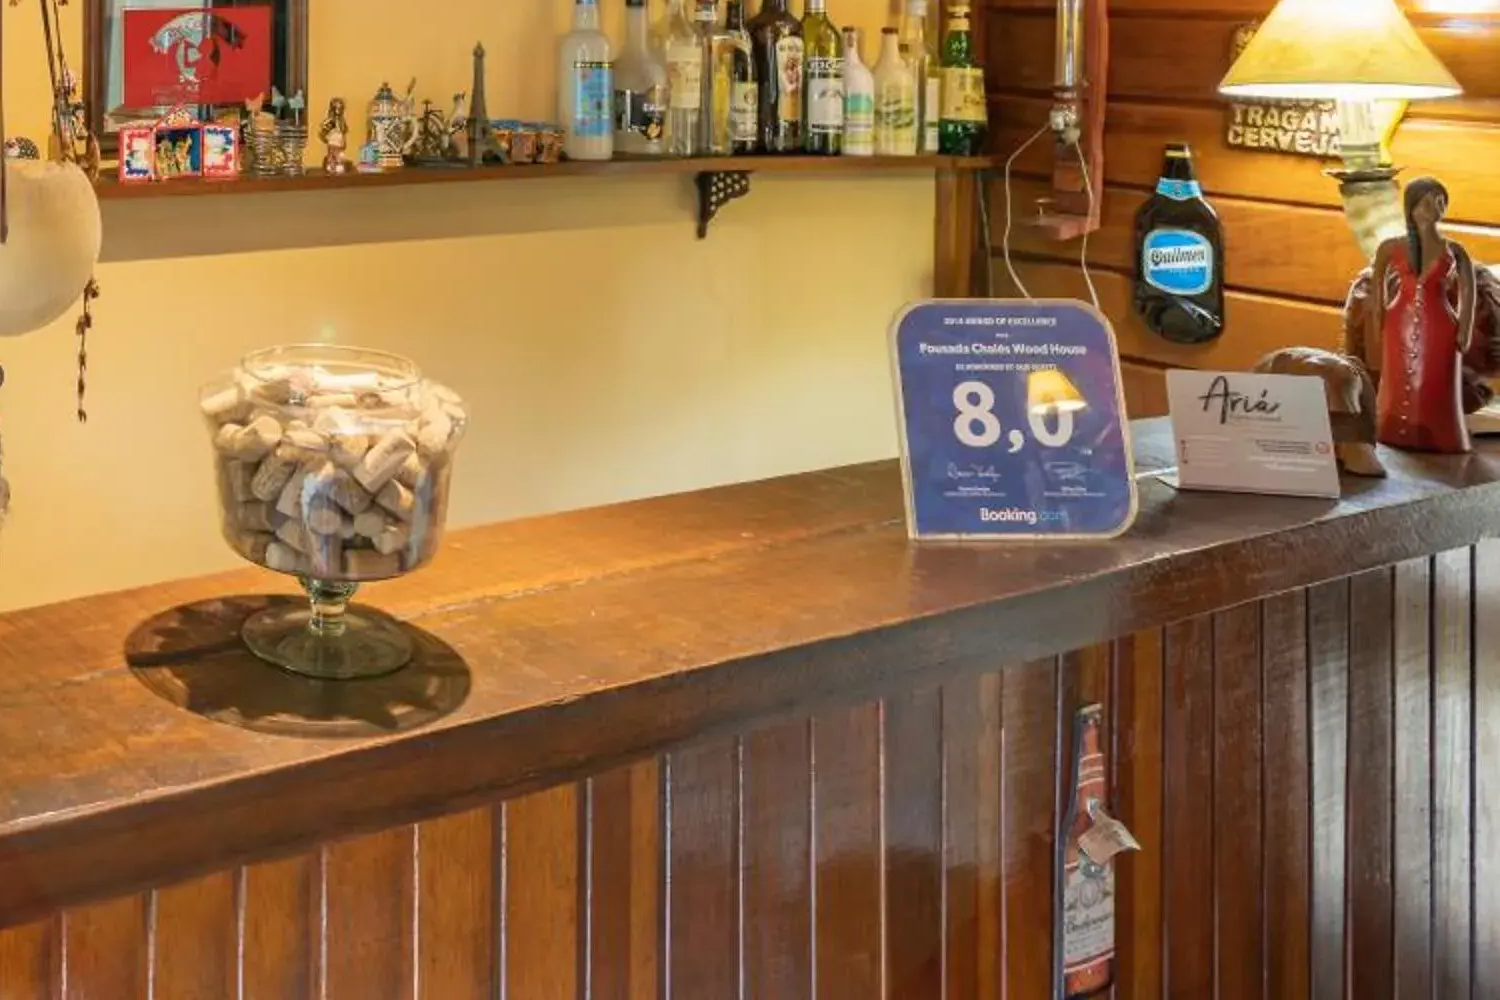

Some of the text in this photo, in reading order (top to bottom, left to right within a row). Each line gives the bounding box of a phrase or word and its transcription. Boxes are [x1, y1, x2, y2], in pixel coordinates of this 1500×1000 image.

[1232, 105, 1340, 135] TRAGAM
[919, 342, 970, 355] Pousada
[1012, 343, 1049, 355] Wood
[1050, 344, 1087, 356] House
[1197, 375, 1281, 425] Ariá
